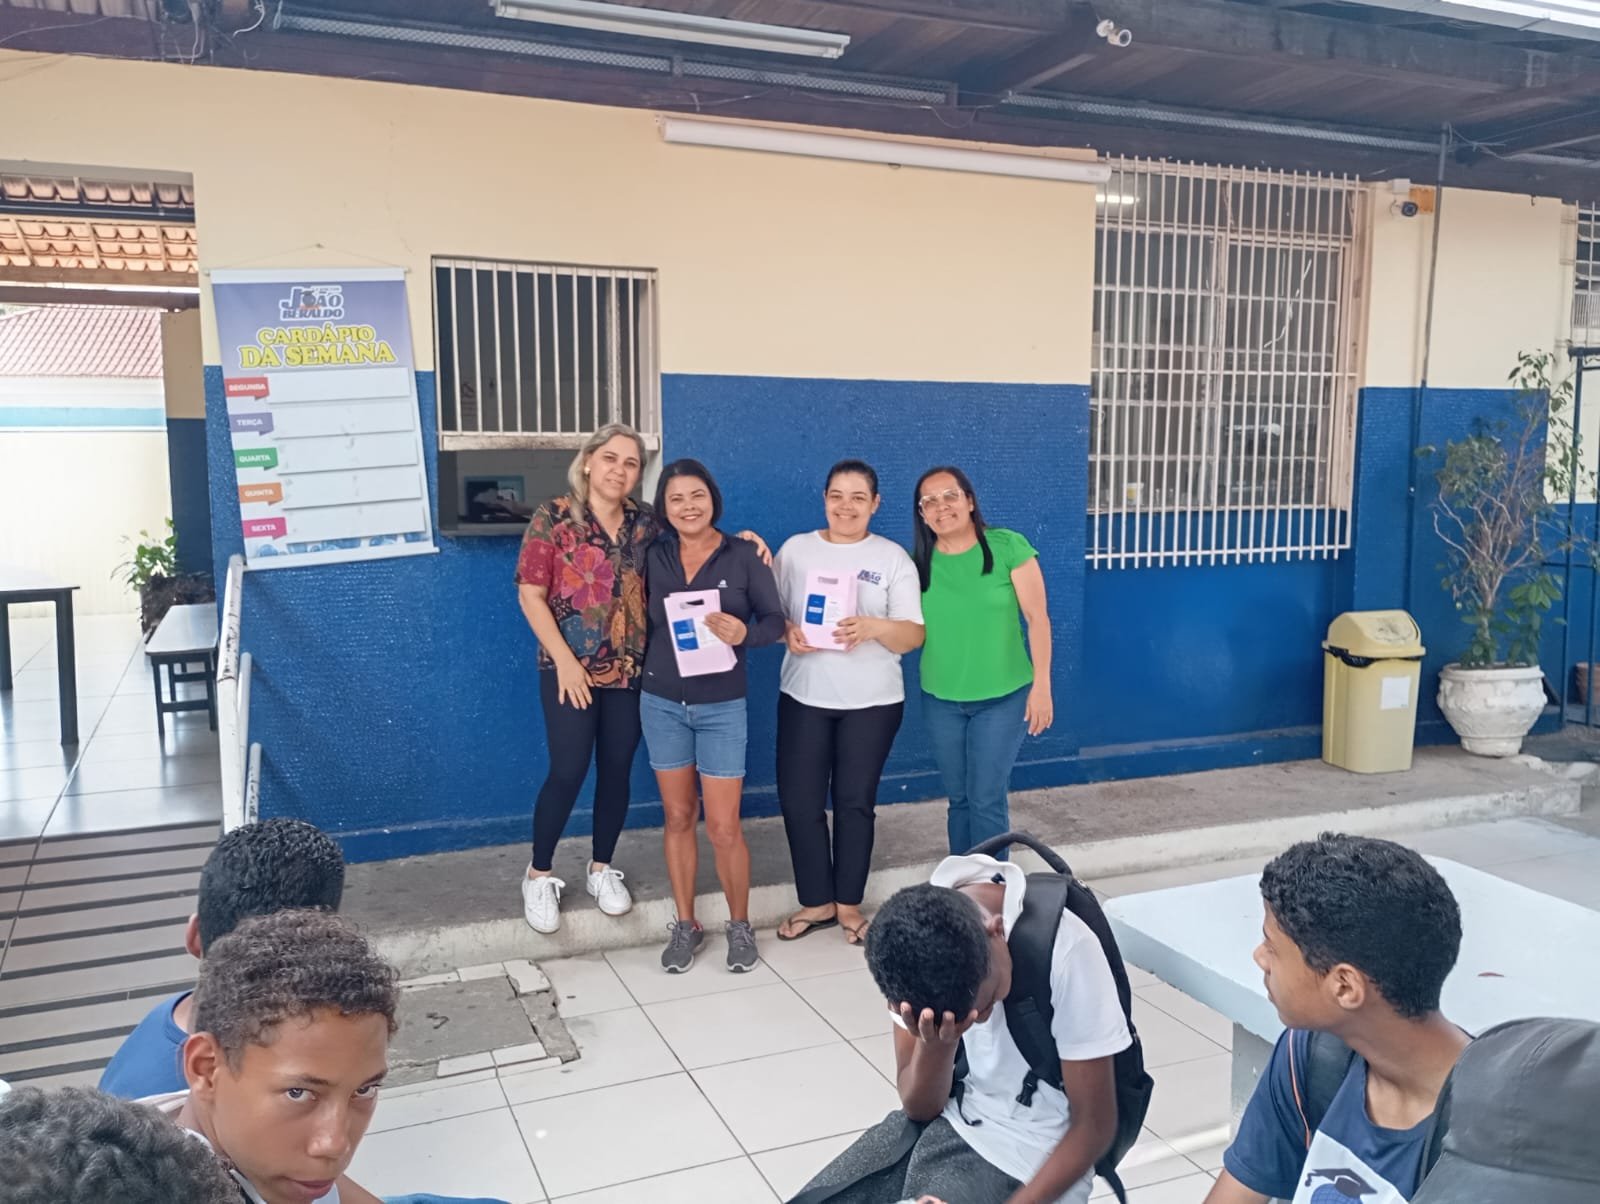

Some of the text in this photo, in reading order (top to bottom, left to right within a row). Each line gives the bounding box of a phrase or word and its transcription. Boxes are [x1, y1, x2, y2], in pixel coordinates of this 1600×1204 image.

[282, 308, 343, 319] BERALDO
[258, 323, 375, 346] CARDÁPIO
[239, 342, 396, 369] DA SEMANA
[228, 383, 267, 392] SEGUNDA
[236, 418, 263, 427] TERÇA
[239, 454, 272, 463] QUARTA
[244, 489, 275, 498] QUINTA
[251, 524, 277, 533] SEXTA
